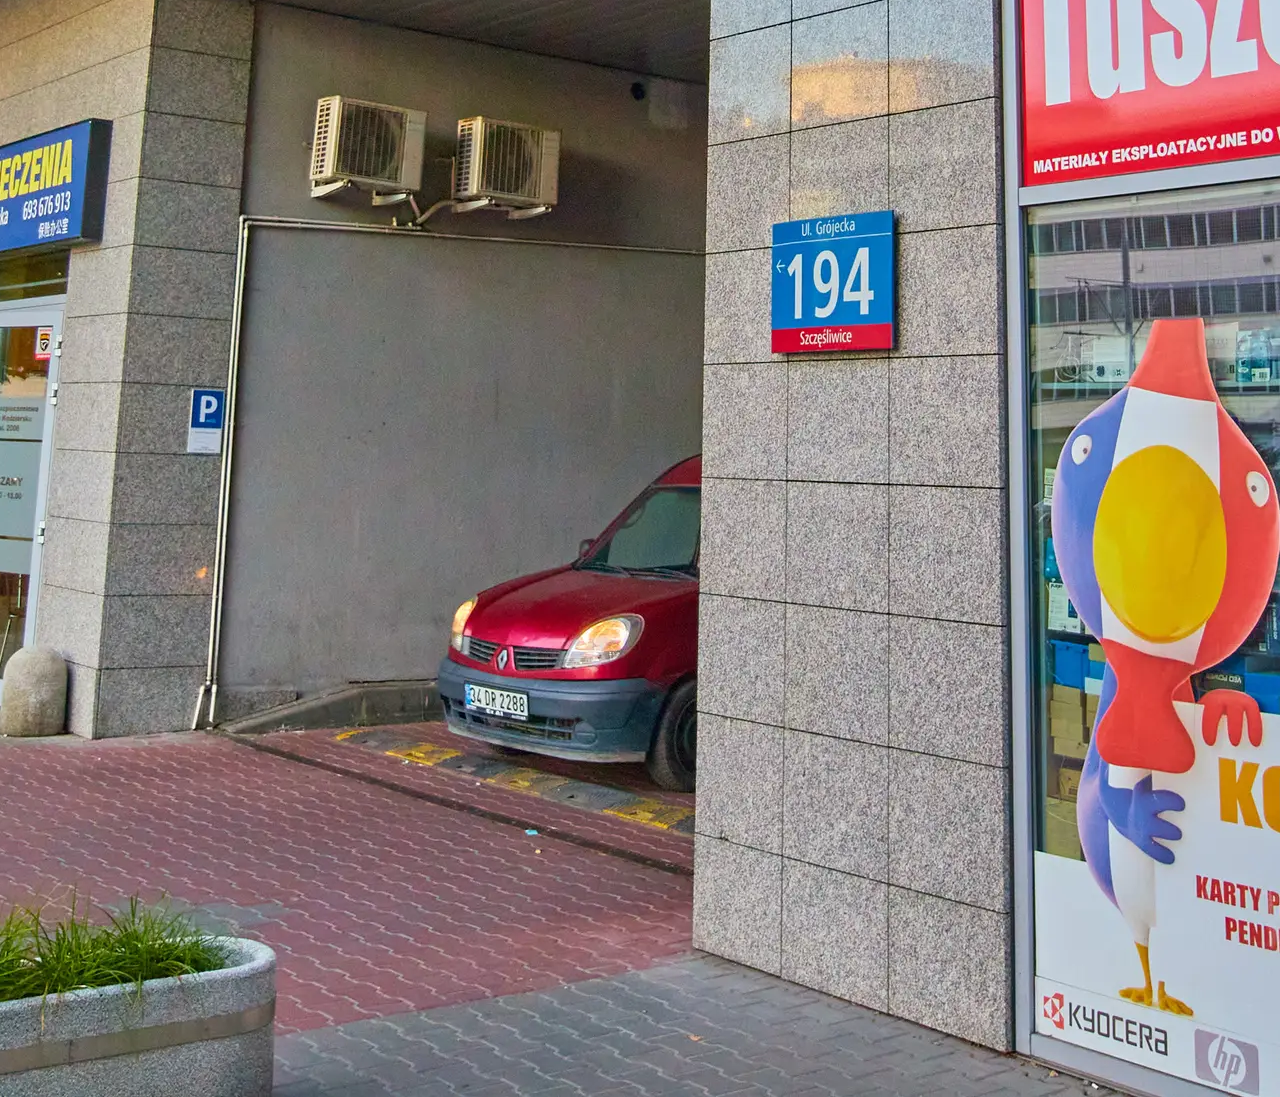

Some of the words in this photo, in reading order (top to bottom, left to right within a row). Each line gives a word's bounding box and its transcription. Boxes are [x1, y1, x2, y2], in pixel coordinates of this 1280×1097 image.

[1033, 150, 1109, 174] MATERIAŁY
[1111, 130, 1248, 164] EKSPLOATACYJNE
[1251, 126, 1275, 145] DO
[22, 200, 37, 220] 693
[38, 195, 53, 216] 676
[54, 191, 71, 214] 913
[801, 223, 812, 236] Ul.
[816, 218, 856, 237] Grójecka
[787, 247, 874, 319] 194
[800, 329, 852, 347] Szczęśliwice
[199, 395, 218, 422] P
[470, 688, 481, 703] 34
[485, 690, 496, 708] DR
[500, 693, 525, 713] 2288
[1196, 875, 1261, 912] KARTY
[1069, 1002, 1168, 1056] KYOCERA
[1213, 1037, 1241, 1086] hp
